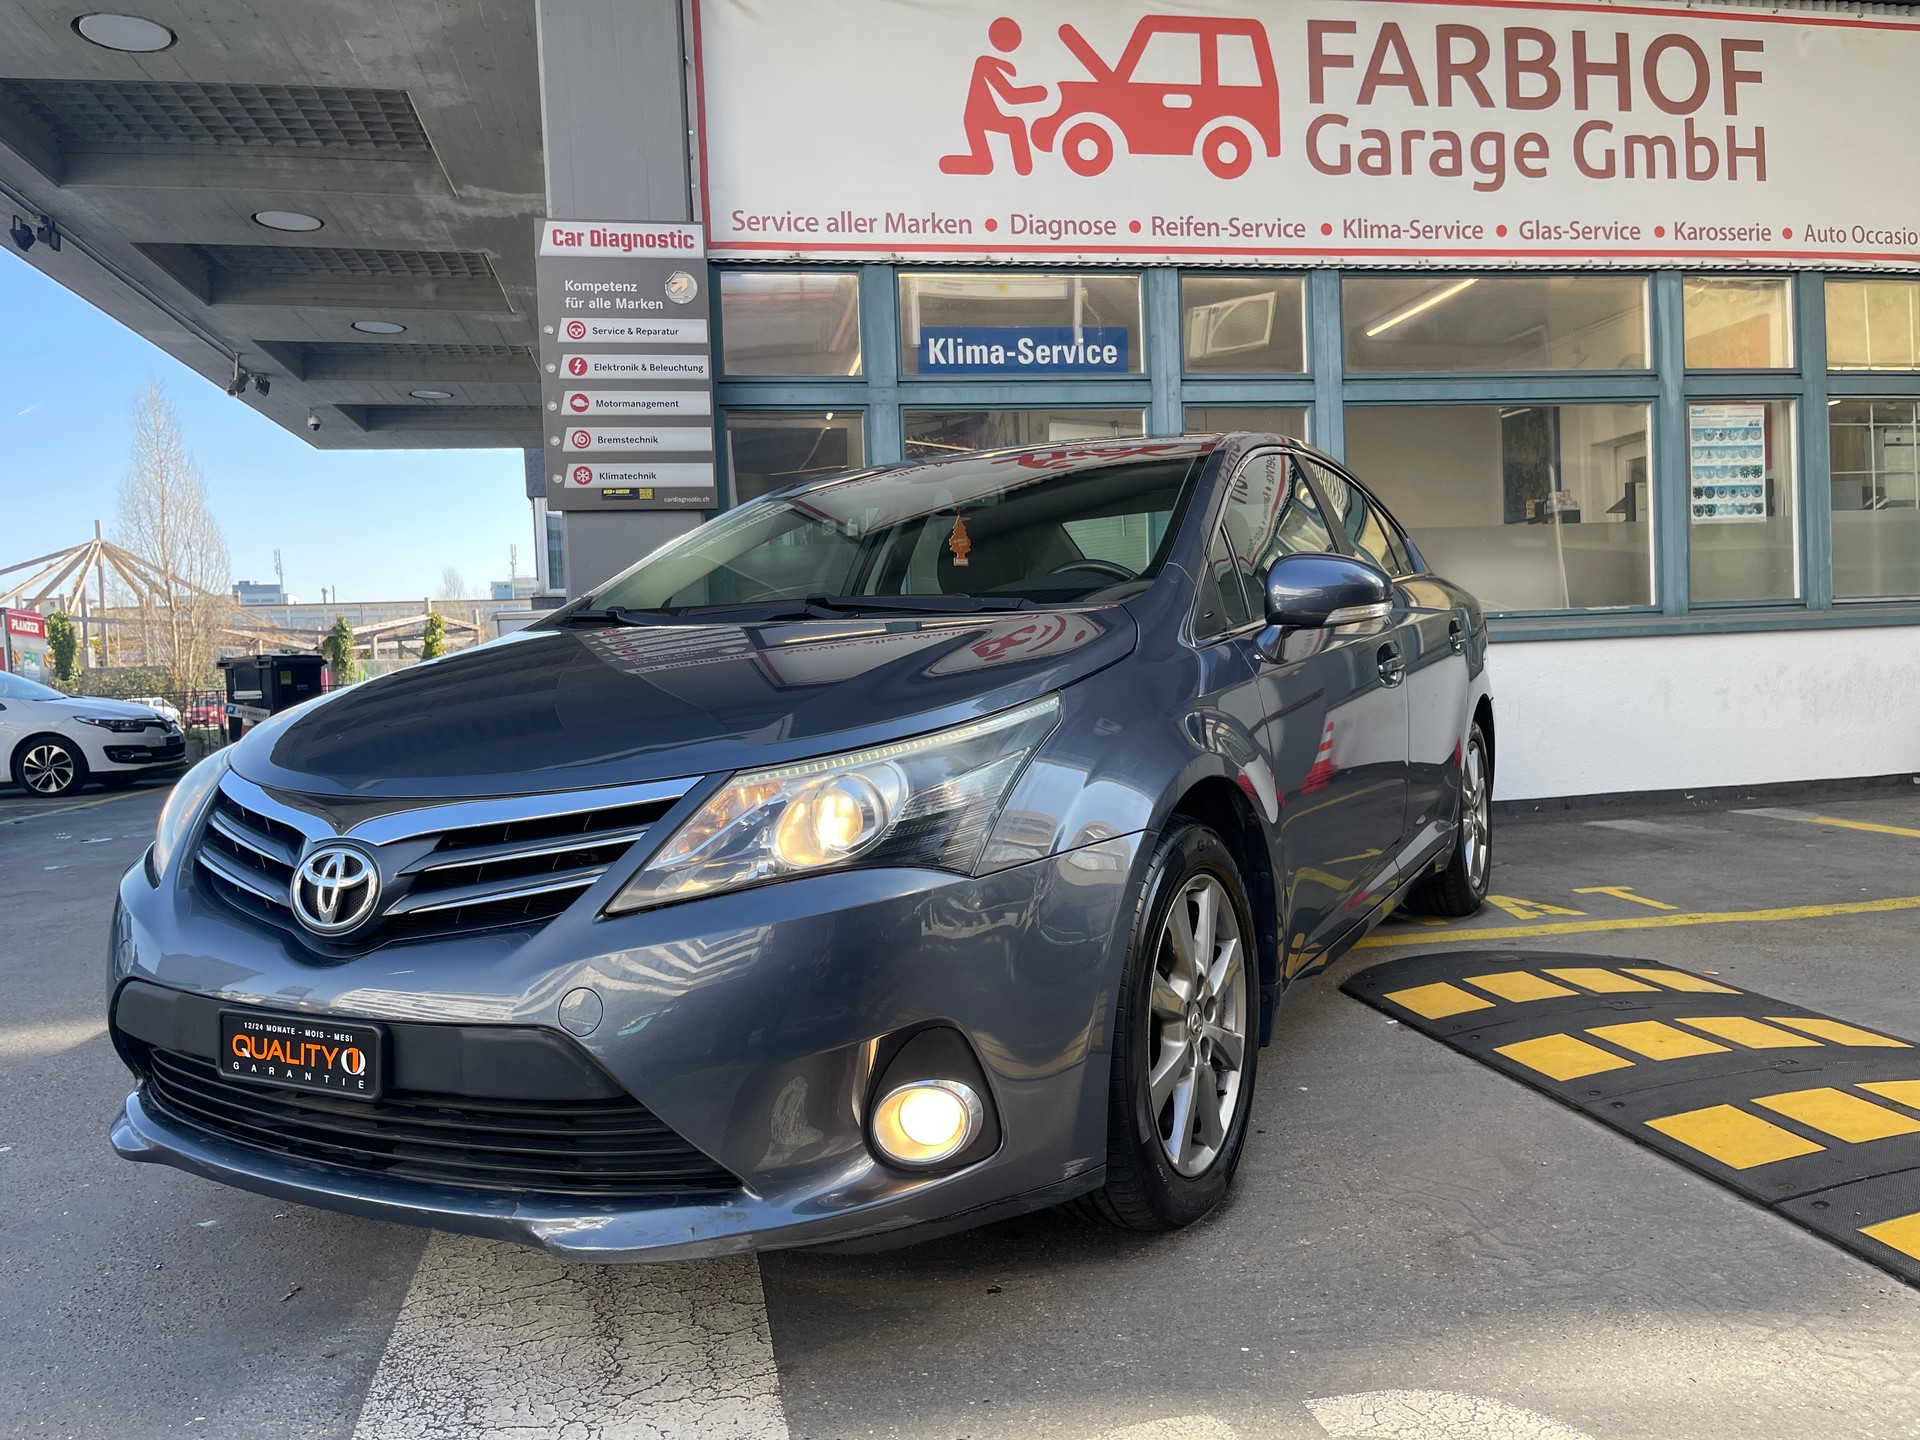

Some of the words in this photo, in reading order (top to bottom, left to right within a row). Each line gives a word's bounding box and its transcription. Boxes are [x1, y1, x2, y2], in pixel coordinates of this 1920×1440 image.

[1306, 19, 1764, 116] FARBHOF
[1305, 114, 1550, 192] Garage
[1572, 117, 1767, 182] GmbH
[731, 209, 819, 234] Service
[826, 210, 878, 235] aller
[885, 212, 973, 236] Marken
[1010, 213, 1117, 240] Diagnose
[1151, 214, 1306, 239] Reifen-Service
[1342, 218, 1484, 242] Klima-Service
[1518, 220, 1641, 243] Glas-Service
[1673, 221, 1772, 243] Karosserie
[1804, 224, 1847, 243] Auto
[1852, 225, 1920, 245] Occasio
[552, 229, 584, 246] Car
[590, 228, 695, 252] Diagnostic
[564, 280, 638, 296] Kompetenz
[565, 296, 585, 309] für
[588, 297, 611, 309] alle
[616, 298, 664, 310] Marken
[592, 326, 625, 336] Service
[636, 327, 680, 338] Reparatur
[928, 337, 1118, 365] Klima-Service
[594, 363, 639, 372] Elektronik
[649, 363, 704, 374] Beleuchtung
[595, 399, 680, 410] Motormanagement
[597, 436, 659, 445] Bremstechnik
[599, 471, 657, 480] Klimatechnik
[11, 618, 40, 634] PLANZER
[244, 1022, 264, 1031] 12/24
[266, 1024, 296, 1035] MONATE
[305, 1029, 324, 1039] MOIS
[334, 1033, 353, 1043] MESI
[232, 1034, 339, 1070] QUALITY
[233, 1061, 365, 1090] GARANTIE
